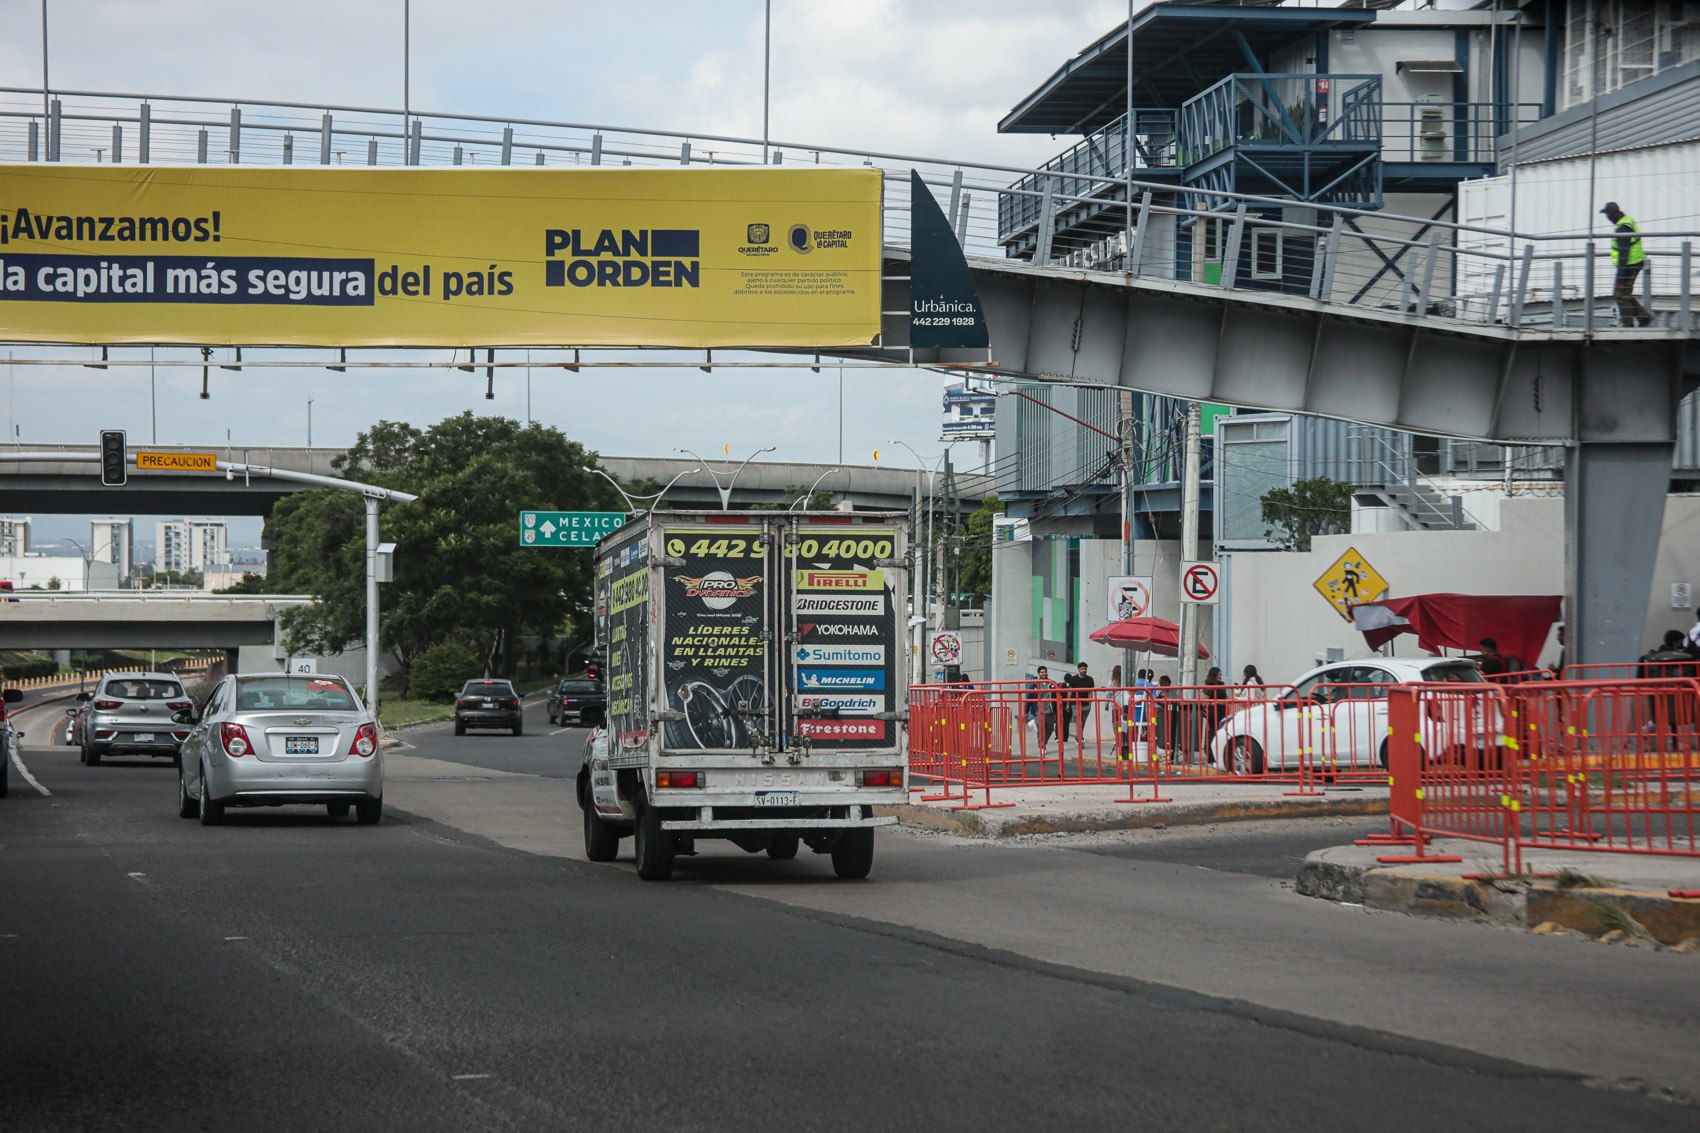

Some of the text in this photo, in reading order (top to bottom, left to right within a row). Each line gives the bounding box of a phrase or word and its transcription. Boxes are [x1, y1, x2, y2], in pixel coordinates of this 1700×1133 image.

[1, 208, 221, 244] ¡Avanzamos!
[546, 229, 648, 257] PLAN
[823, 240, 848, 248] CAPITAL
[567, 260, 699, 287] ORDEN
[0, 259, 514, 300] la capital más segura del país
[912, 317, 975, 326] 442 229 1928
[142, 456, 211, 467] PRECAUCION
[560, 518, 622, 527] MEXICO
[690, 539, 747, 558] 442
[822, 540, 892, 558] 4000
[704, 580, 736, 589] PRO
[808, 573, 867, 587] PIRELLI
[796, 599, 879, 611] BRIDGESTONE
[688, 624, 750, 634] LÍDERES
[816, 624, 878, 635] YOKOHAMA
[813, 649, 881, 660] Sumitomo
[691, 658, 701, 666] Y
[704, 658, 749, 666] RINES
[298, 664, 311, 673] 40
